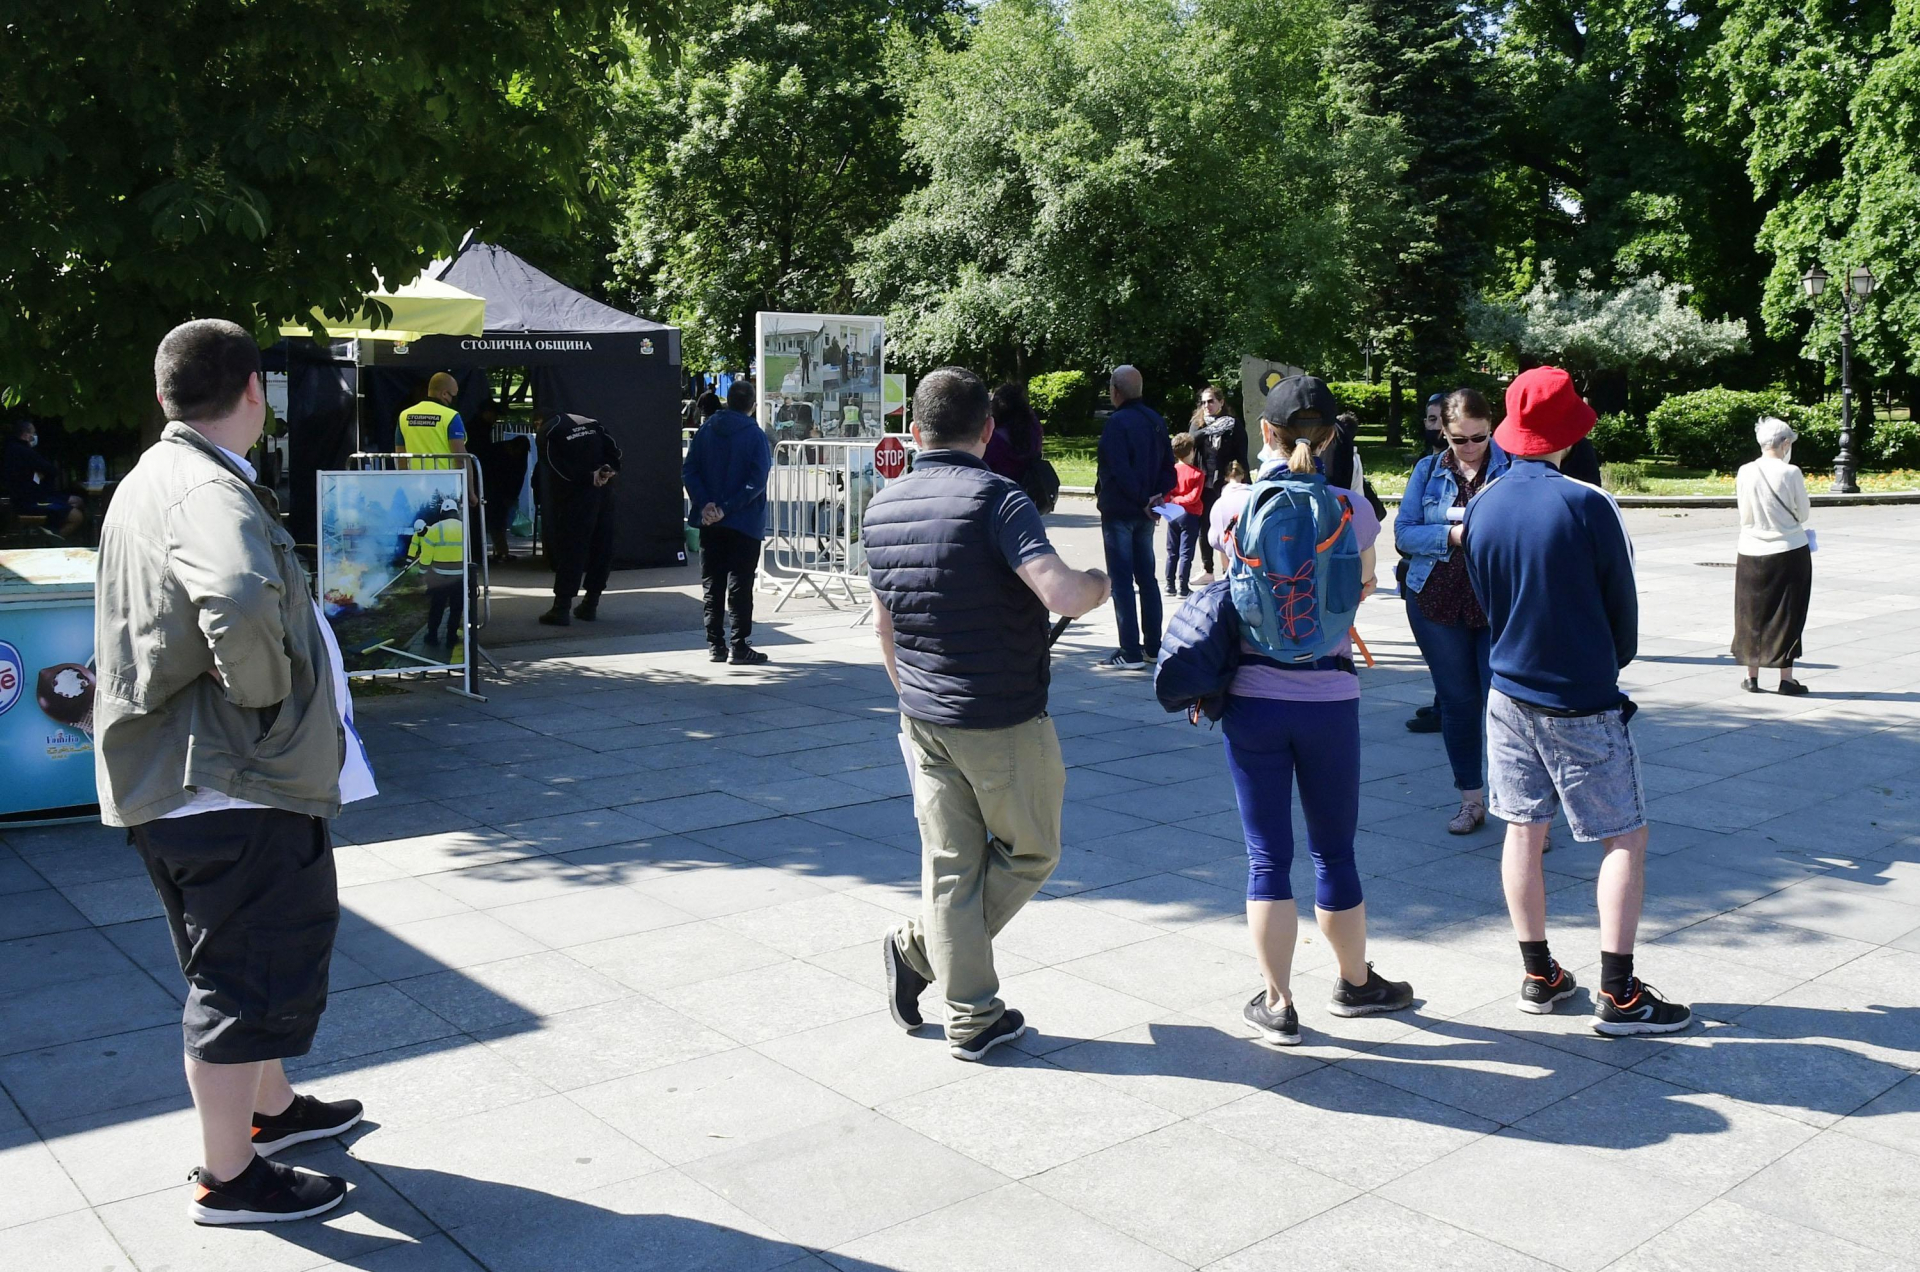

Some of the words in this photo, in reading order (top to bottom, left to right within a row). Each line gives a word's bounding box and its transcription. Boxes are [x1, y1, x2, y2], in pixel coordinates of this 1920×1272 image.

[460, 339, 533, 350] СТОЛИЧНА
[535, 340, 593, 352] ОБЩИНА
[876, 450, 904, 467] STOP
